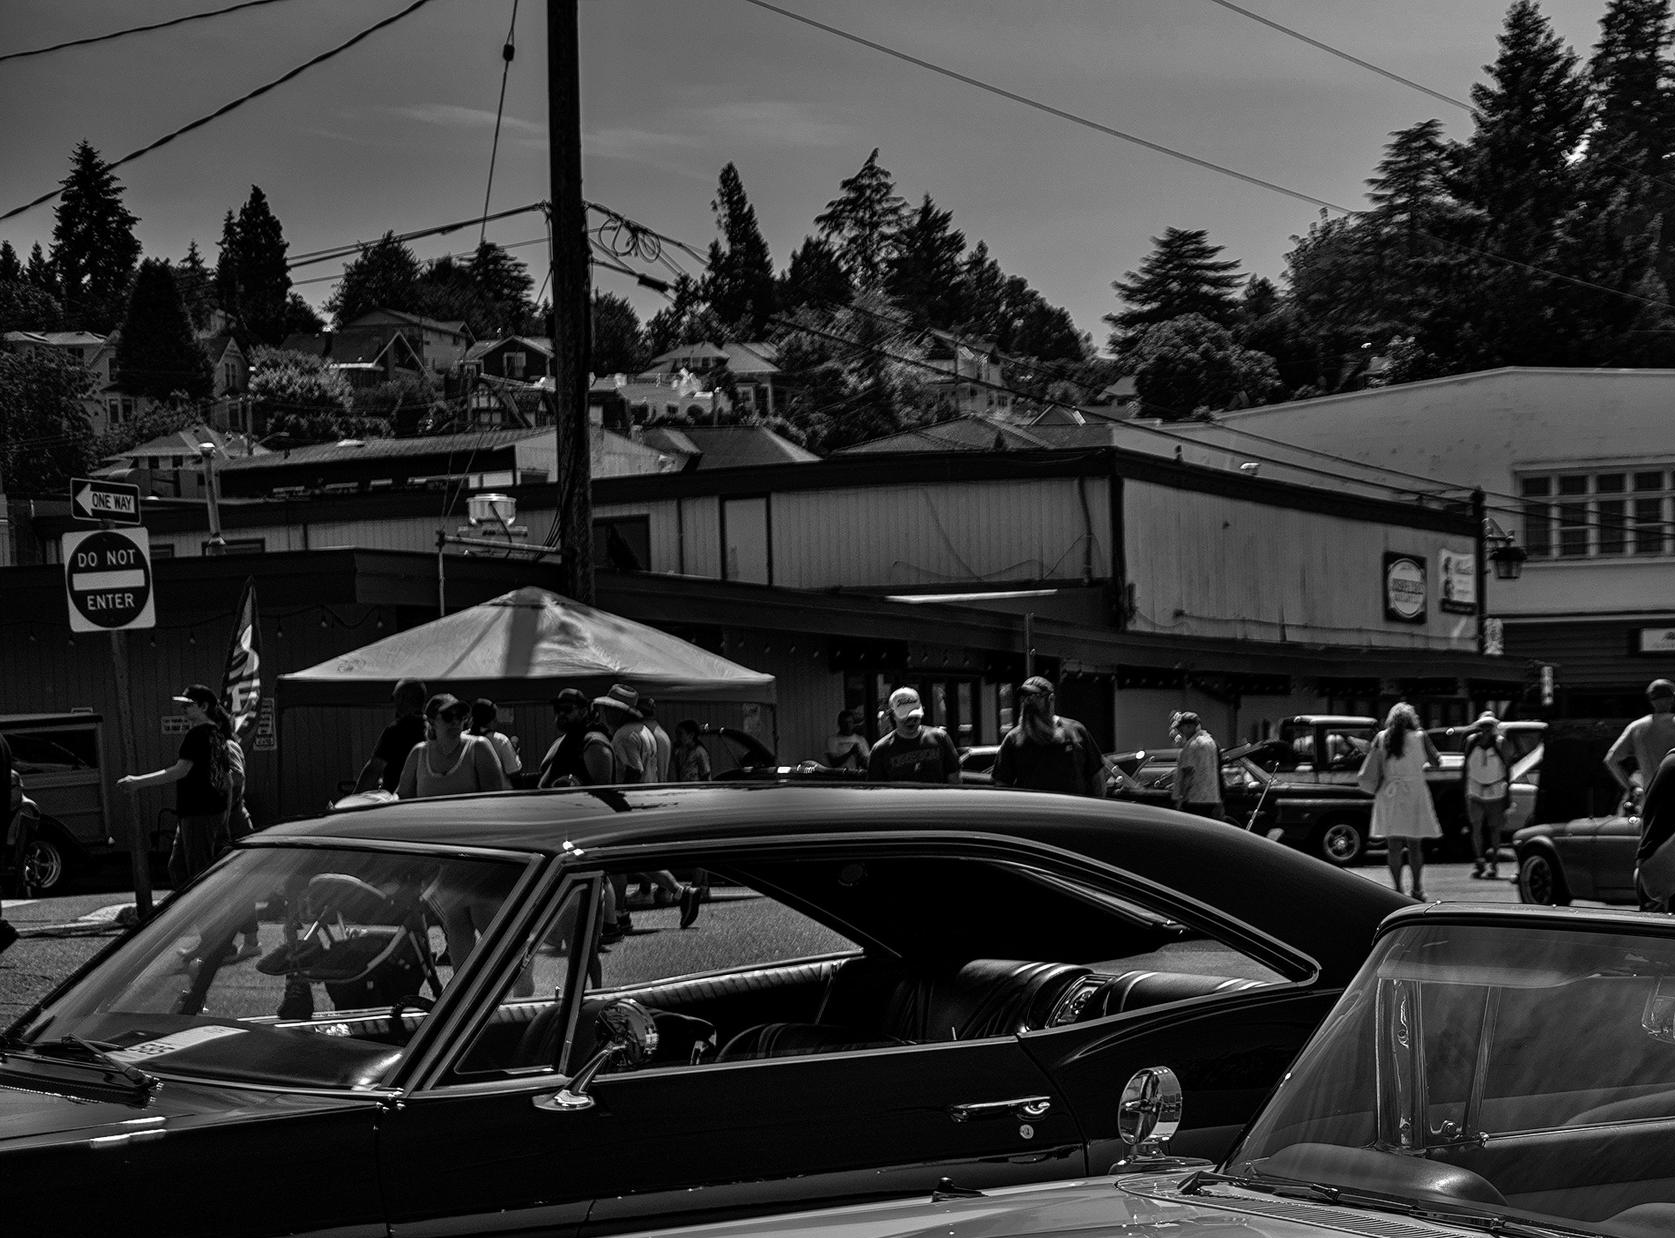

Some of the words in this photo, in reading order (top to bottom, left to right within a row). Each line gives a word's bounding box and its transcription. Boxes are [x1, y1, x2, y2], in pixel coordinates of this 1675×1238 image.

[92, 492, 112, 509] ONE
[114, 495, 132, 511] WAY
[77, 552, 98, 568] DO
[106, 549, 136, 566] NOT
[86, 592, 135, 610] ENTER
